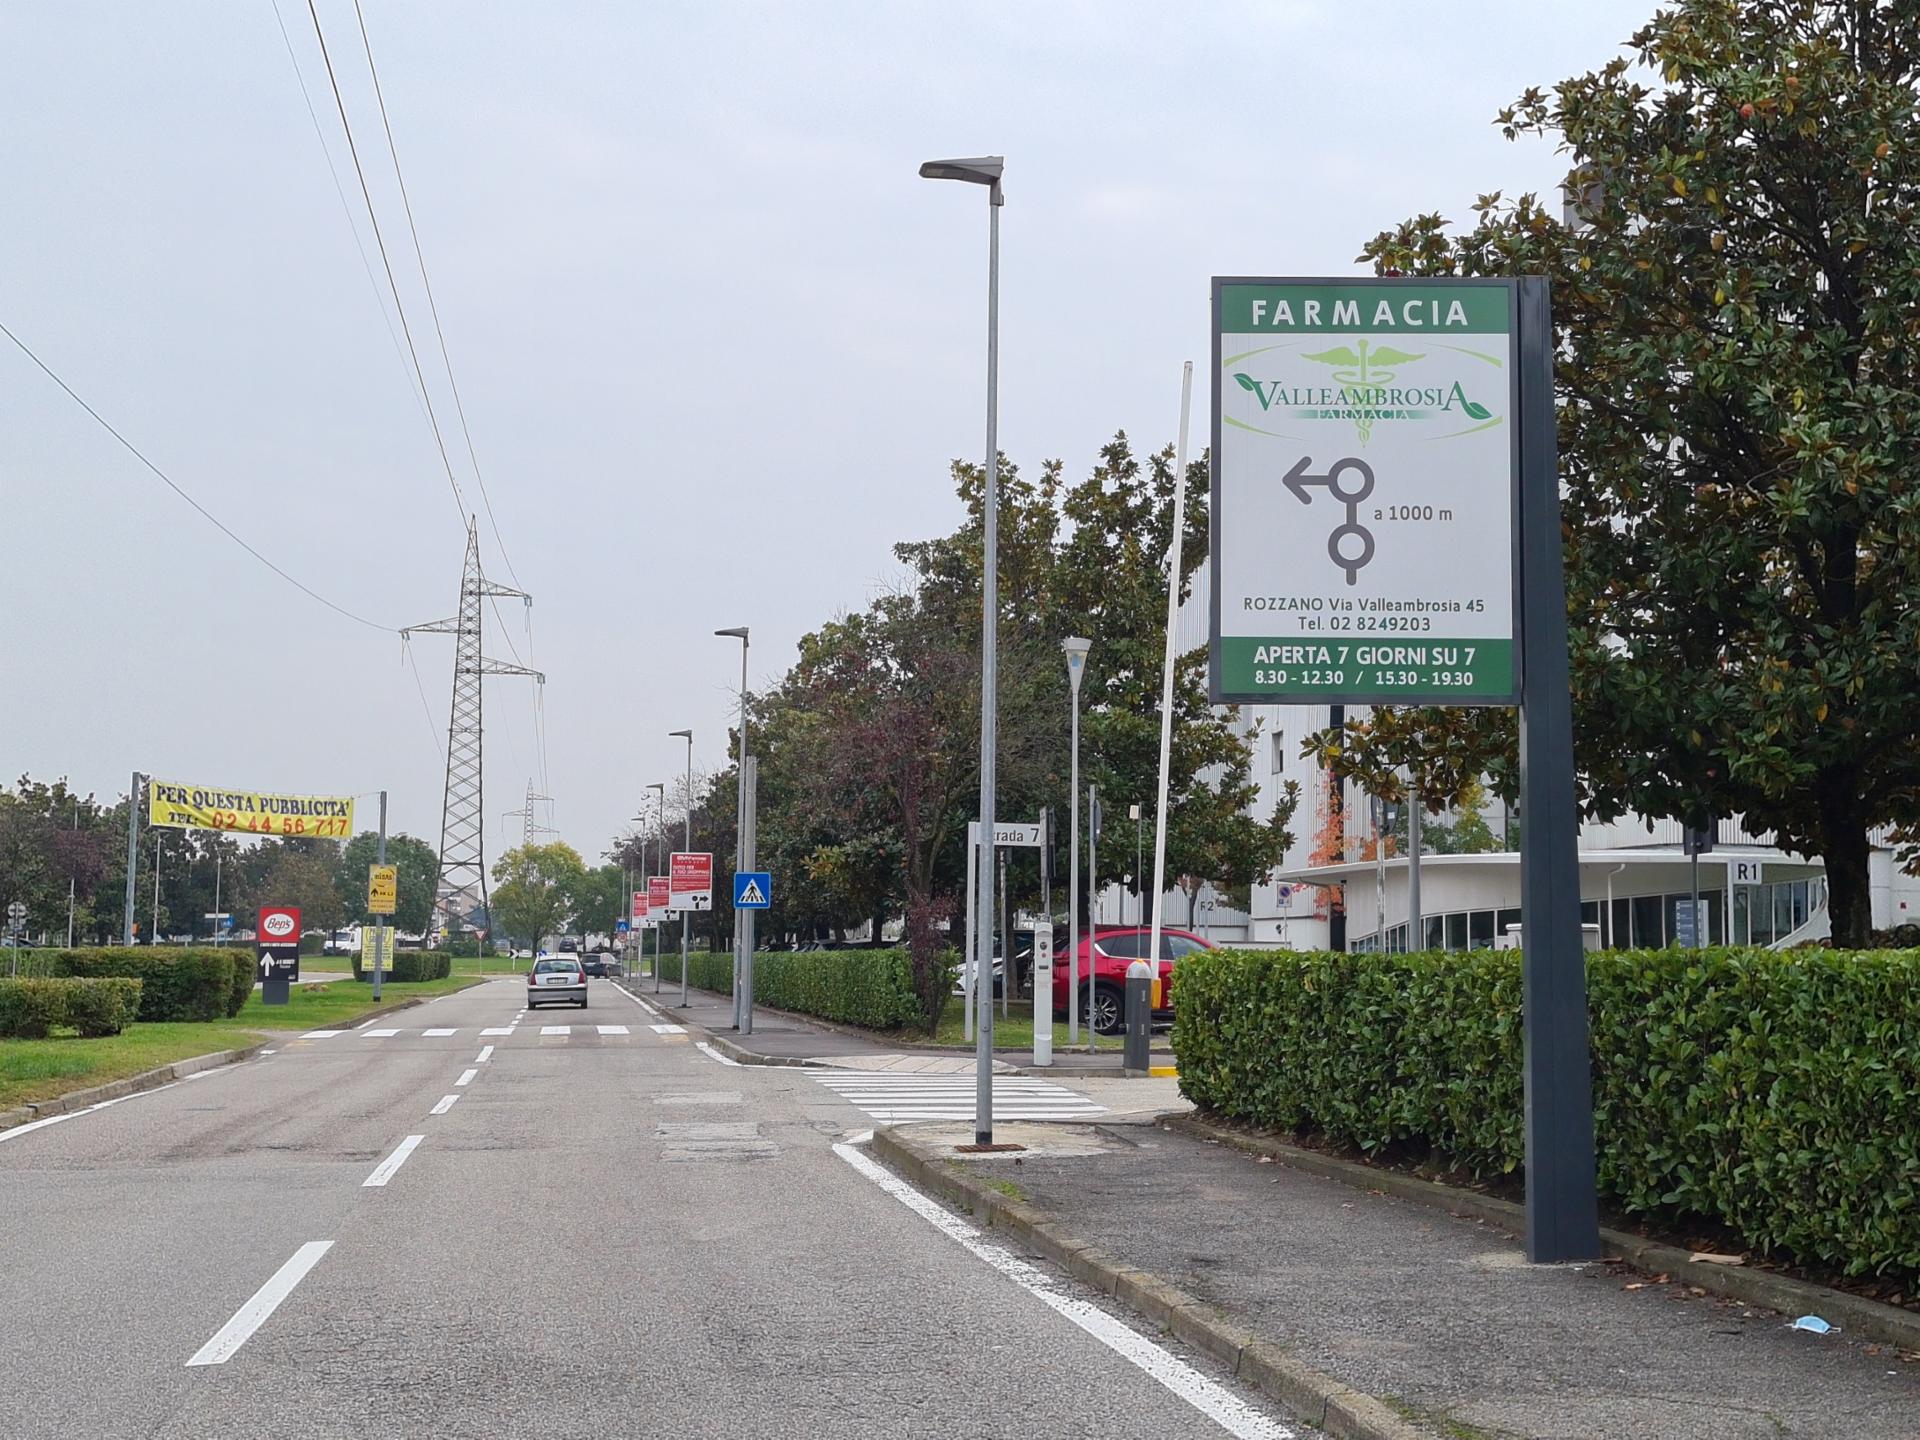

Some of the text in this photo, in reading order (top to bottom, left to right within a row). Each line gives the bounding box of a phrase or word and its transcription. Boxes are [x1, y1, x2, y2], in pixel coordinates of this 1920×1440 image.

[1252, 300, 1468, 326] FARMACIA
[1252, 380, 1474, 412] VALLEAMBROSIA
[1317, 409, 1410, 420] FARMACIA
[1374, 505, 1452, 520] a 1000 m
[1243, 597, 1485, 612] ROZZANO Via Valleambrosia 45
[1298, 616, 1431, 631] Tel. 02 8249203
[1253, 646, 1475, 665] APERTA 7 GIORNI SU 7
[1255, 670, 1287, 684] 8.30
[1301, 671, 1344, 684] 12.30
[1355, 671, 1363, 685] /
[1376, 671, 1417, 685] 15.30
[1432, 672, 1473, 686] 19.30
[156, 784, 349, 816] PER QUESTA PUBBLICITA'
[168, 811, 348, 836] TEL: 02 44 56 717
[1030, 827, 1040, 842] 7
